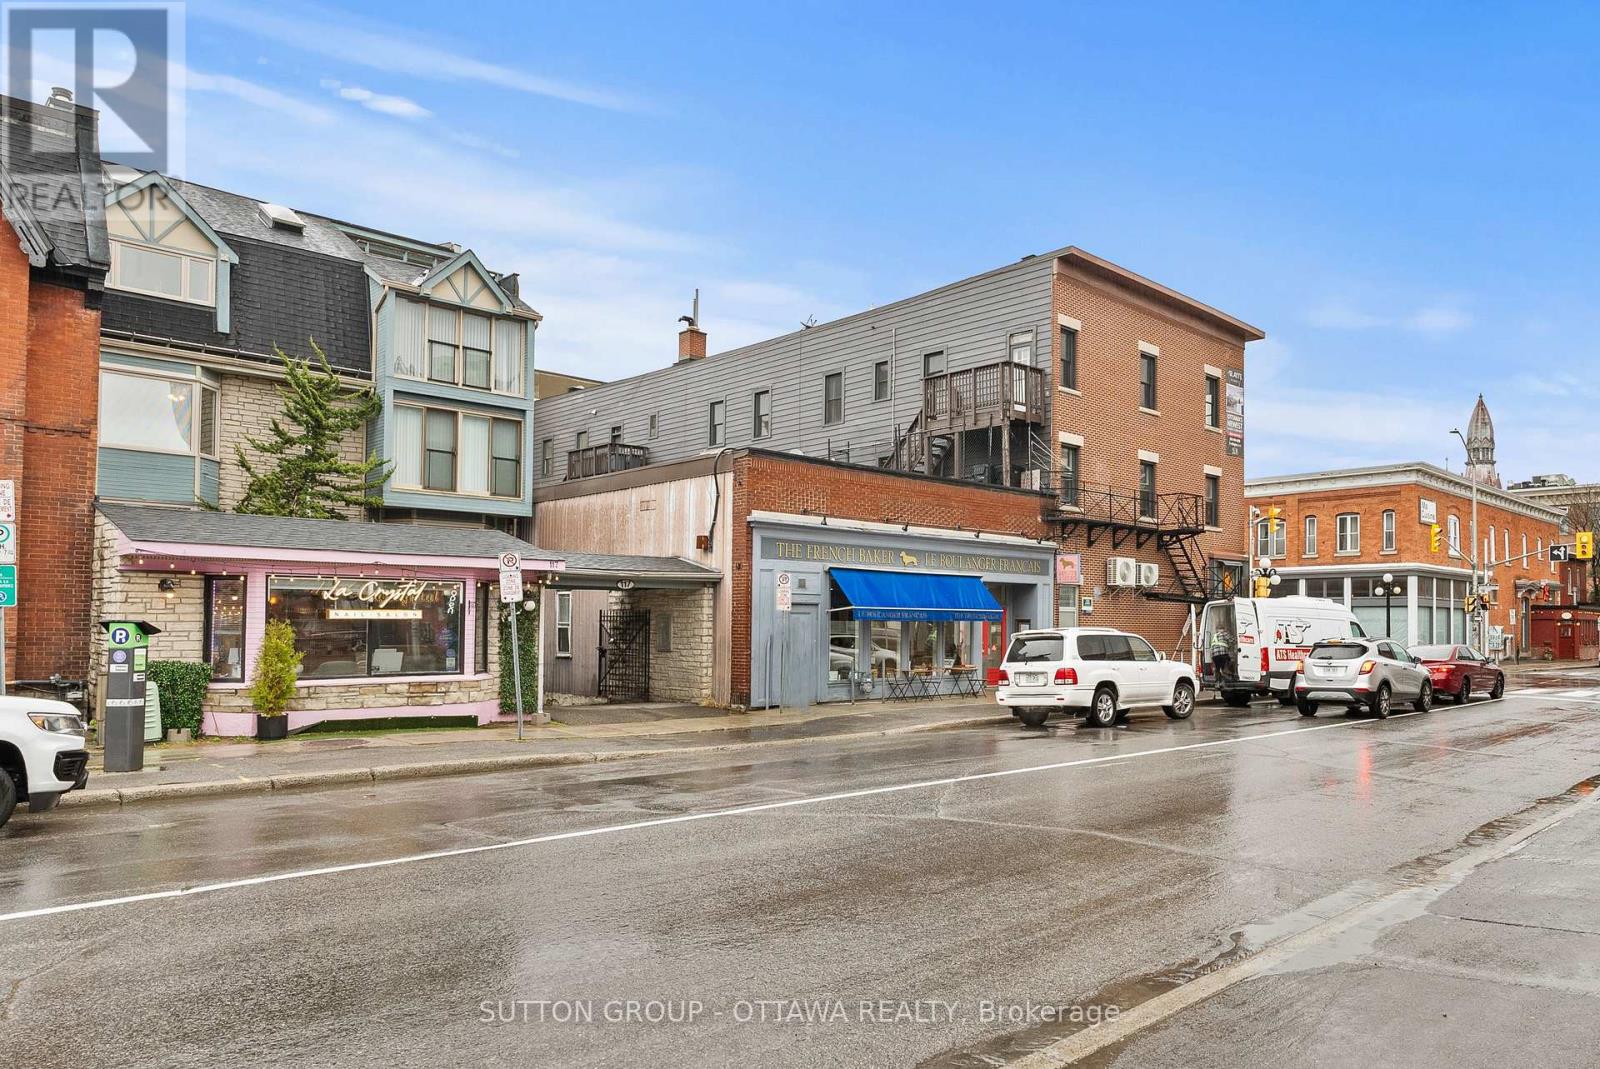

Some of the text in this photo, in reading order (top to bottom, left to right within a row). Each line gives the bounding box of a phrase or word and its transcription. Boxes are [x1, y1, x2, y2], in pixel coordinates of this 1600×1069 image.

[776, 542, 802, 558] THE
[807, 544, 856, 562] FRENCH
[859, 548, 895, 564] BAKER
[925, 552, 936, 566] LE
[940, 553, 998, 571] BOULANGER
[323, 579, 428, 608] La Crystal
[1276, 649, 1287, 660] ATS
